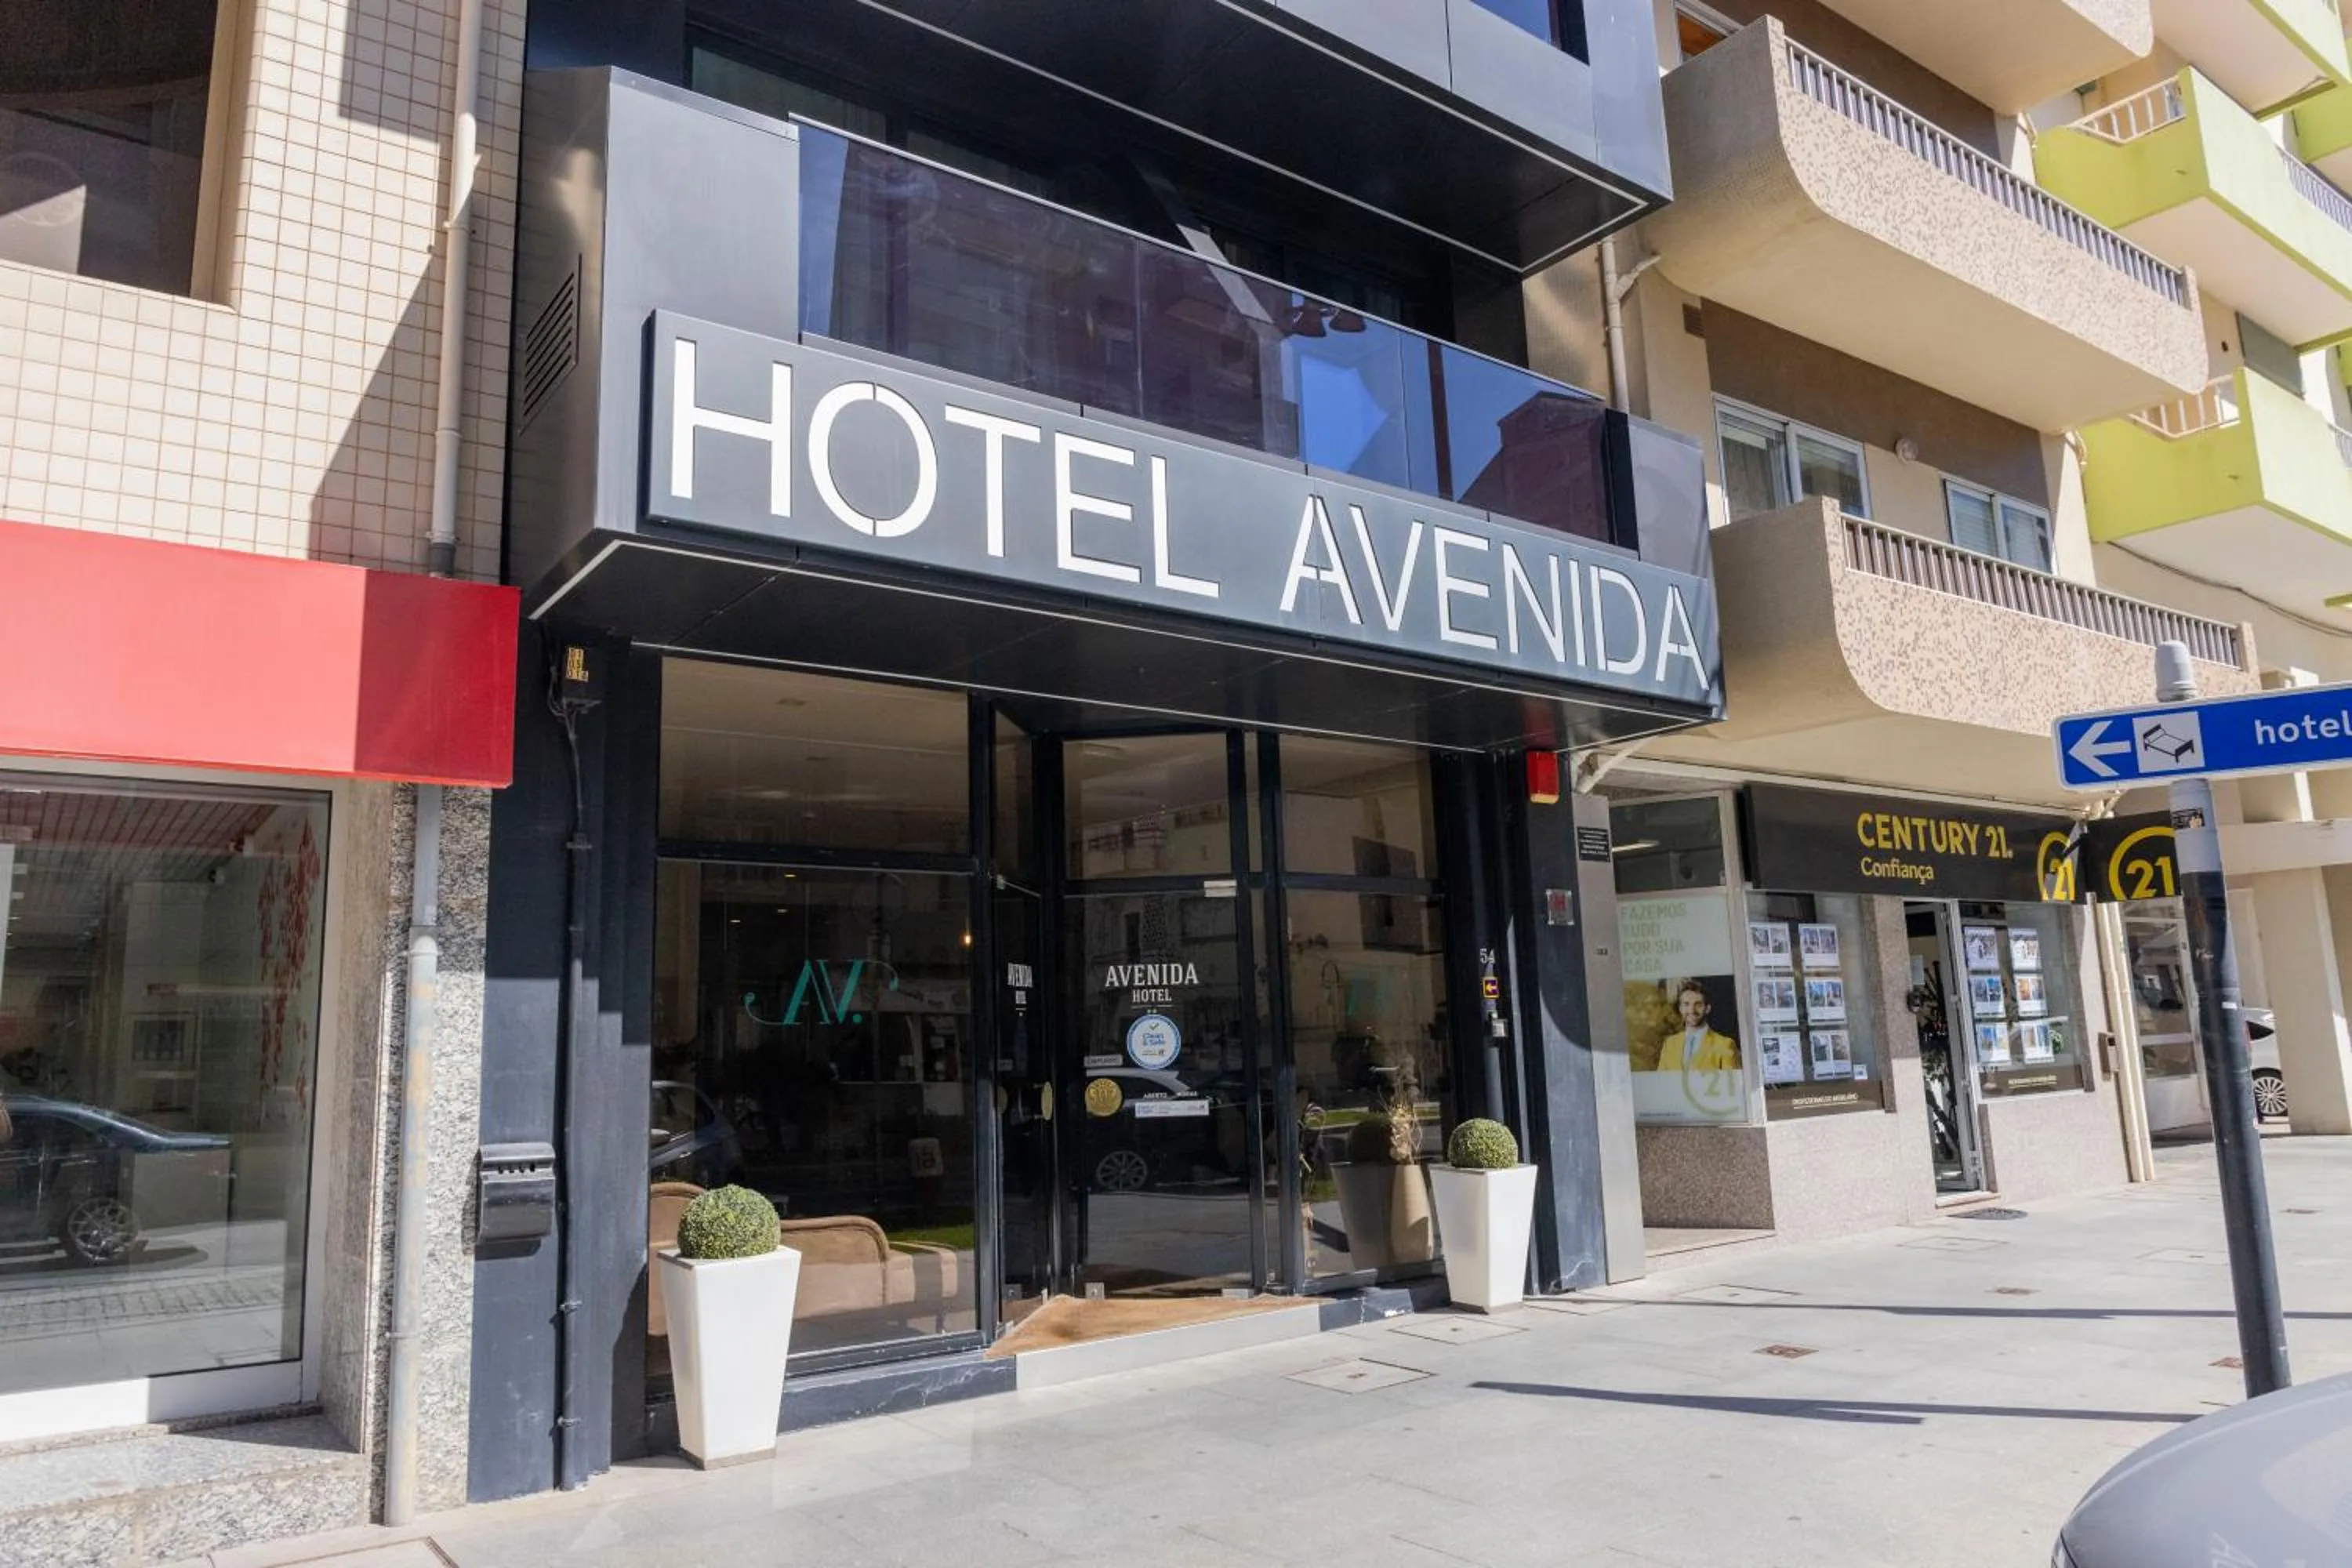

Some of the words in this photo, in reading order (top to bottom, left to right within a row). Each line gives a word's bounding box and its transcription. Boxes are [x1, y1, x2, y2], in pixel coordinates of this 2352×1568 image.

[670, 337, 1220, 598] HOTEL
[1280, 495, 1708, 690] AVENIDA
[2255, 710, 2352, 746] hotel
[1857, 812, 1980, 855] CENTURY
[1860, 857, 1934, 885] Confiança
[2127, 856, 2175, 900] 21
[1621, 903, 1686, 920] FAZEMOS
[1105, 963, 1200, 987] AVENIDA
[1132, 989, 1172, 1003] HOTEL
